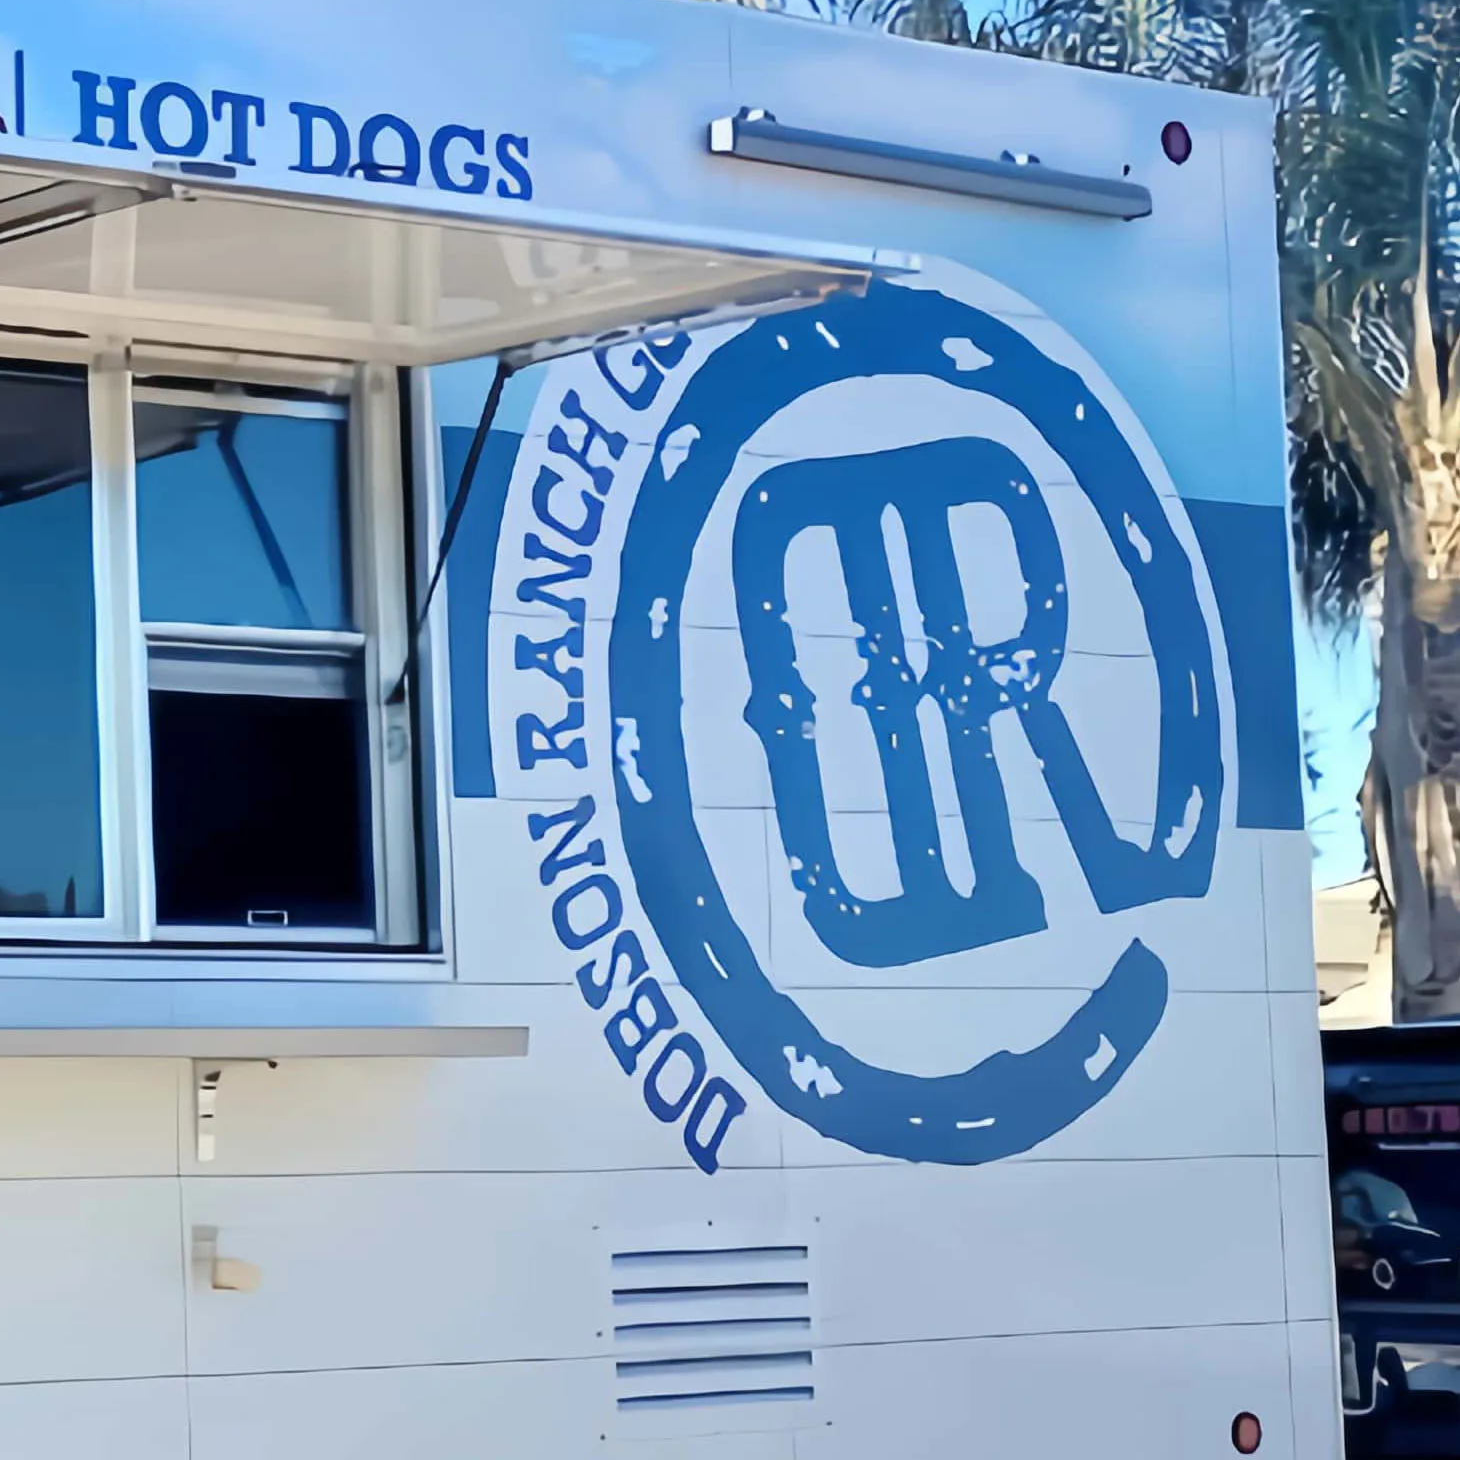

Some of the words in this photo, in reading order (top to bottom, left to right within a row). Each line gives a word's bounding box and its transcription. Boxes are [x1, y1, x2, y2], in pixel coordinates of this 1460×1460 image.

[71, 69, 265, 167] HOT
[288, 101, 533, 201] DOGS
[514, 388, 629, 771] RANCH
[527, 794, 747, 1176] DOBSON
